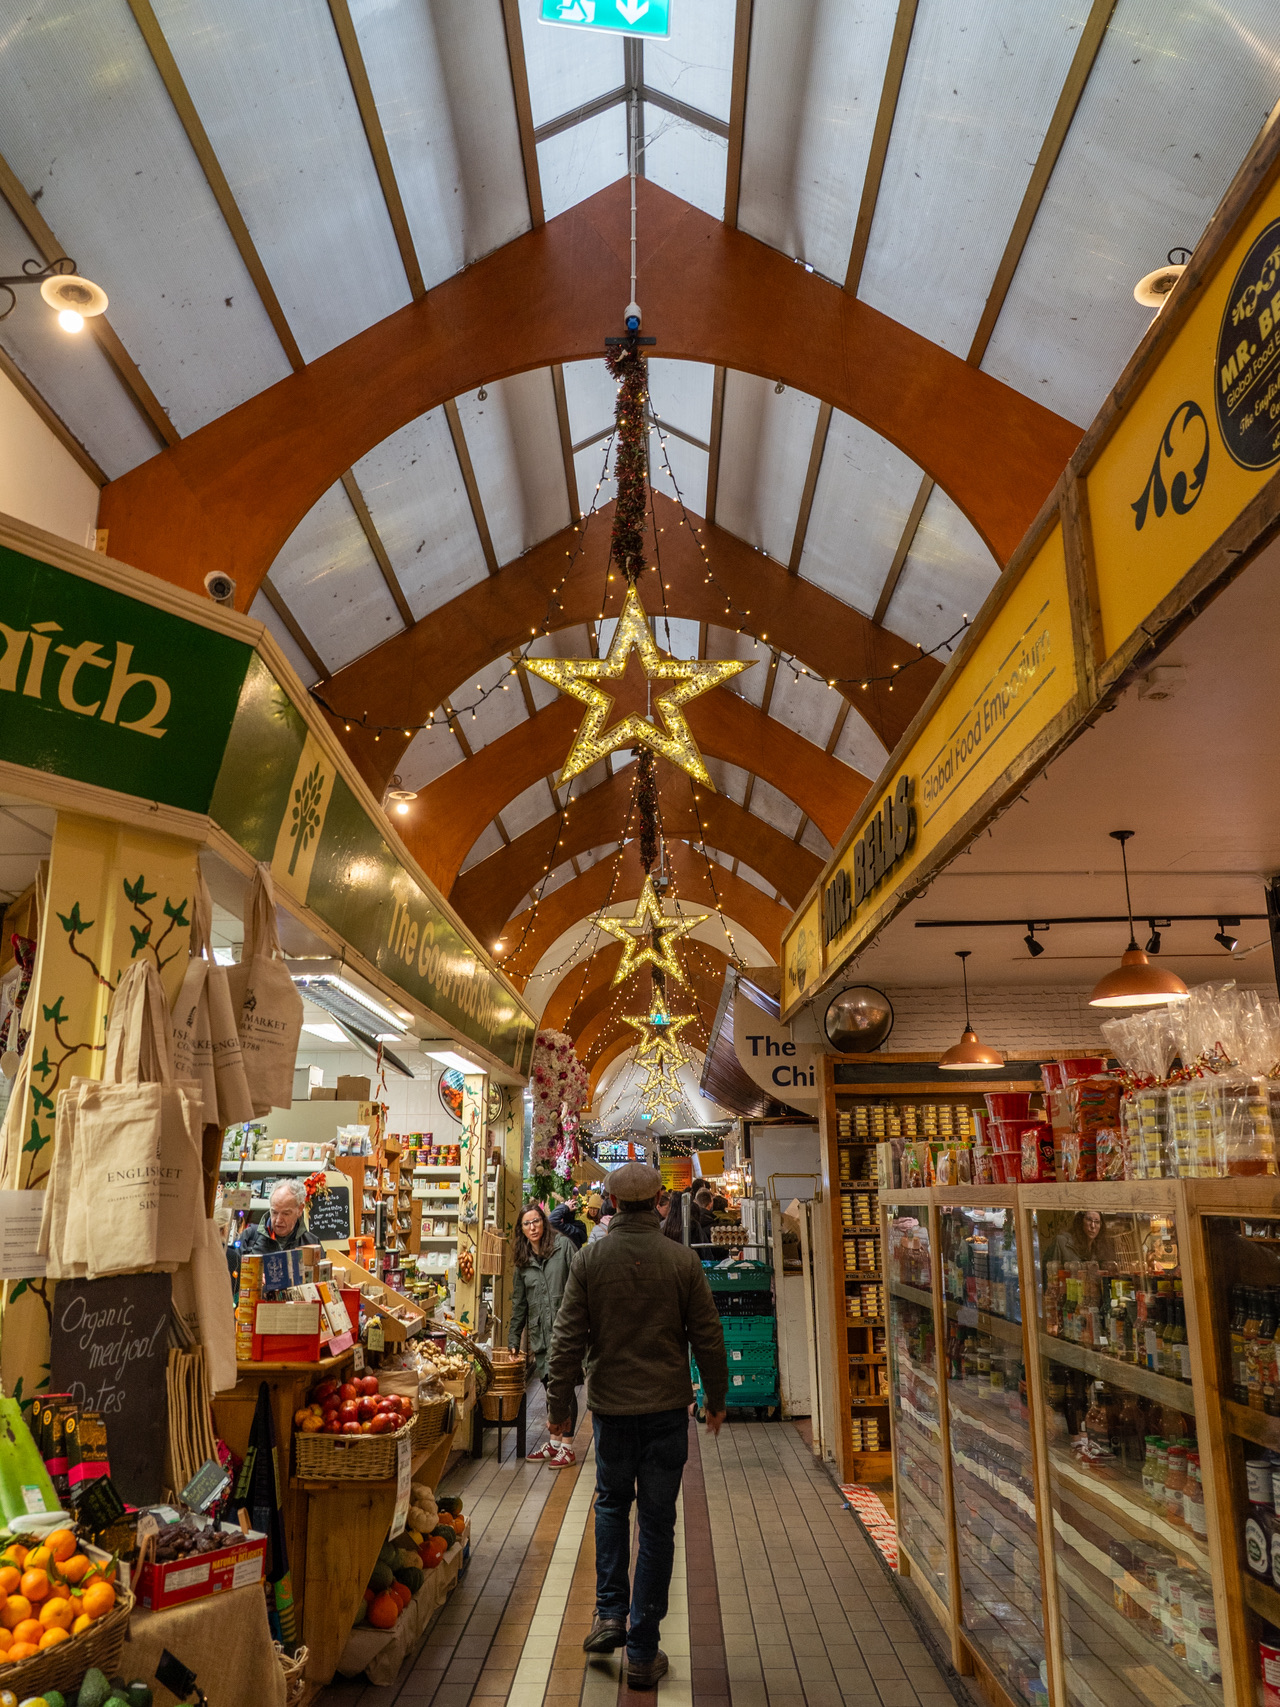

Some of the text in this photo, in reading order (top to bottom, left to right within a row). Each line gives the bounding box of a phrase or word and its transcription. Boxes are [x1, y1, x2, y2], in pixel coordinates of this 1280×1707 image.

[1220, 339, 1258, 394] MR.
[1226, 367, 1253, 408] Global
[1253, 339, 1275, 375] Food
[922, 628, 1053, 810] Global Food Emporium
[823, 774, 917, 948] MR. BELLS
[244, 1013, 288, 1031] MARKET
[242, 1040, 260, 1052] 1788
[745, 1035, 797, 1057] The
[771, 1065, 815, 1087] Chi
[61, 1296, 135, 1350] Organic
[88, 1313, 167, 1381] medjool
[66, 1379, 126, 1414] Dates
[211, 1556, 237, 1570] NATURAL
